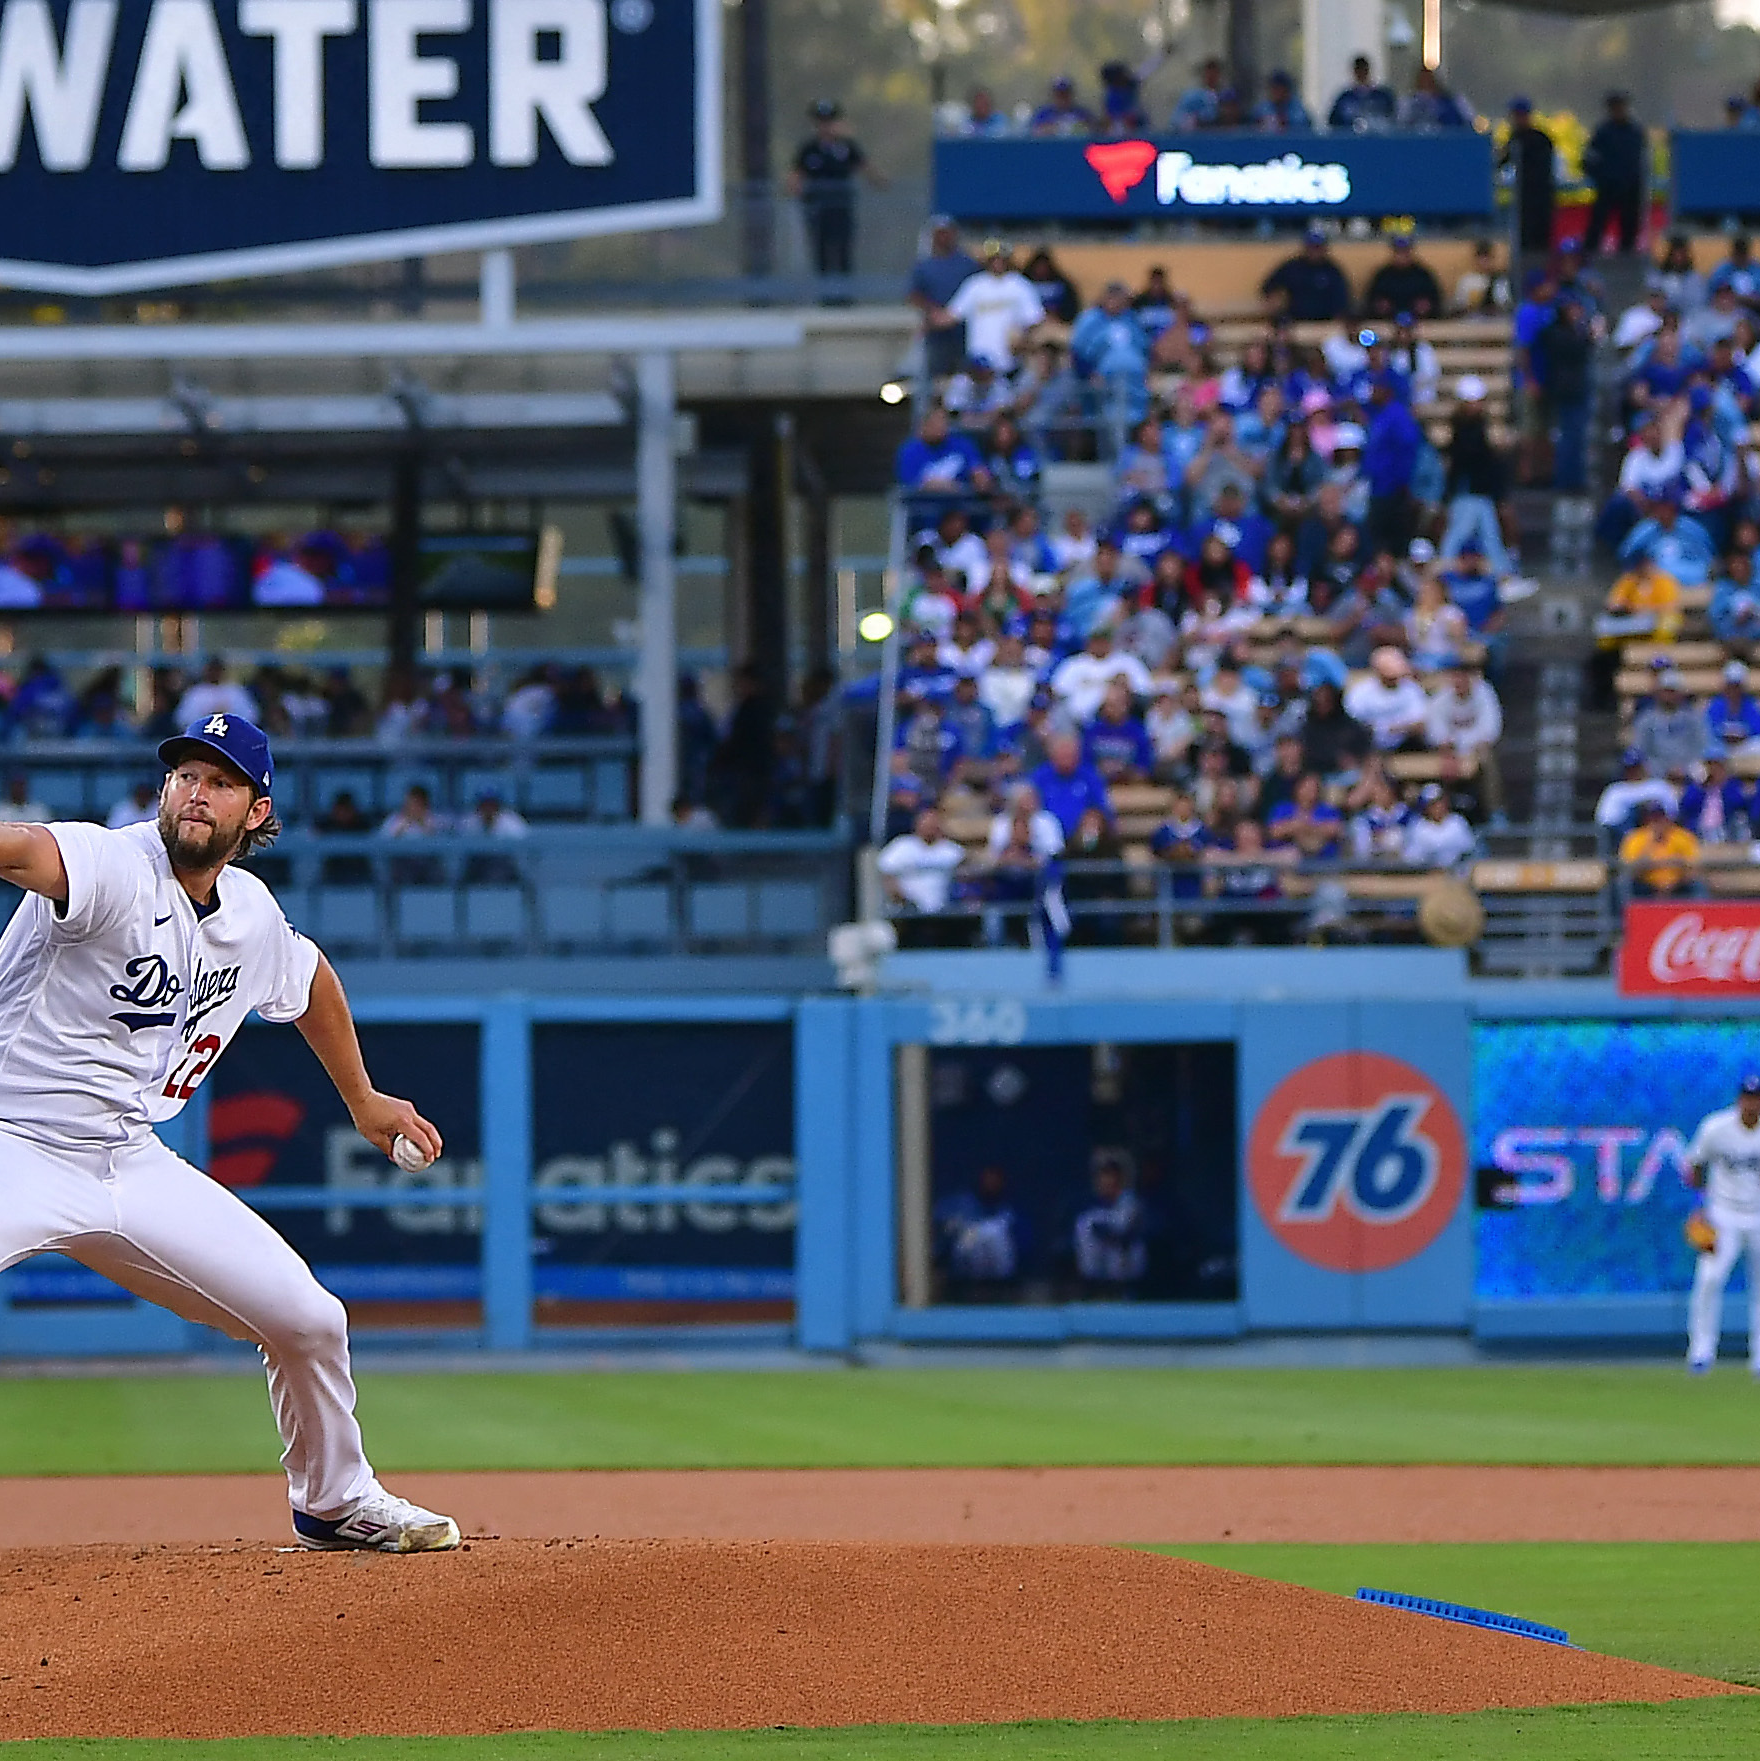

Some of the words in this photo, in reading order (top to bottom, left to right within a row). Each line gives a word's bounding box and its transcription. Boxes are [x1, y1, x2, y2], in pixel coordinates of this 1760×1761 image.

[1156, 151, 1350, 205] Fanatics
[203, 713, 229, 737] LA
[1277, 1095, 1442, 1225] 76
